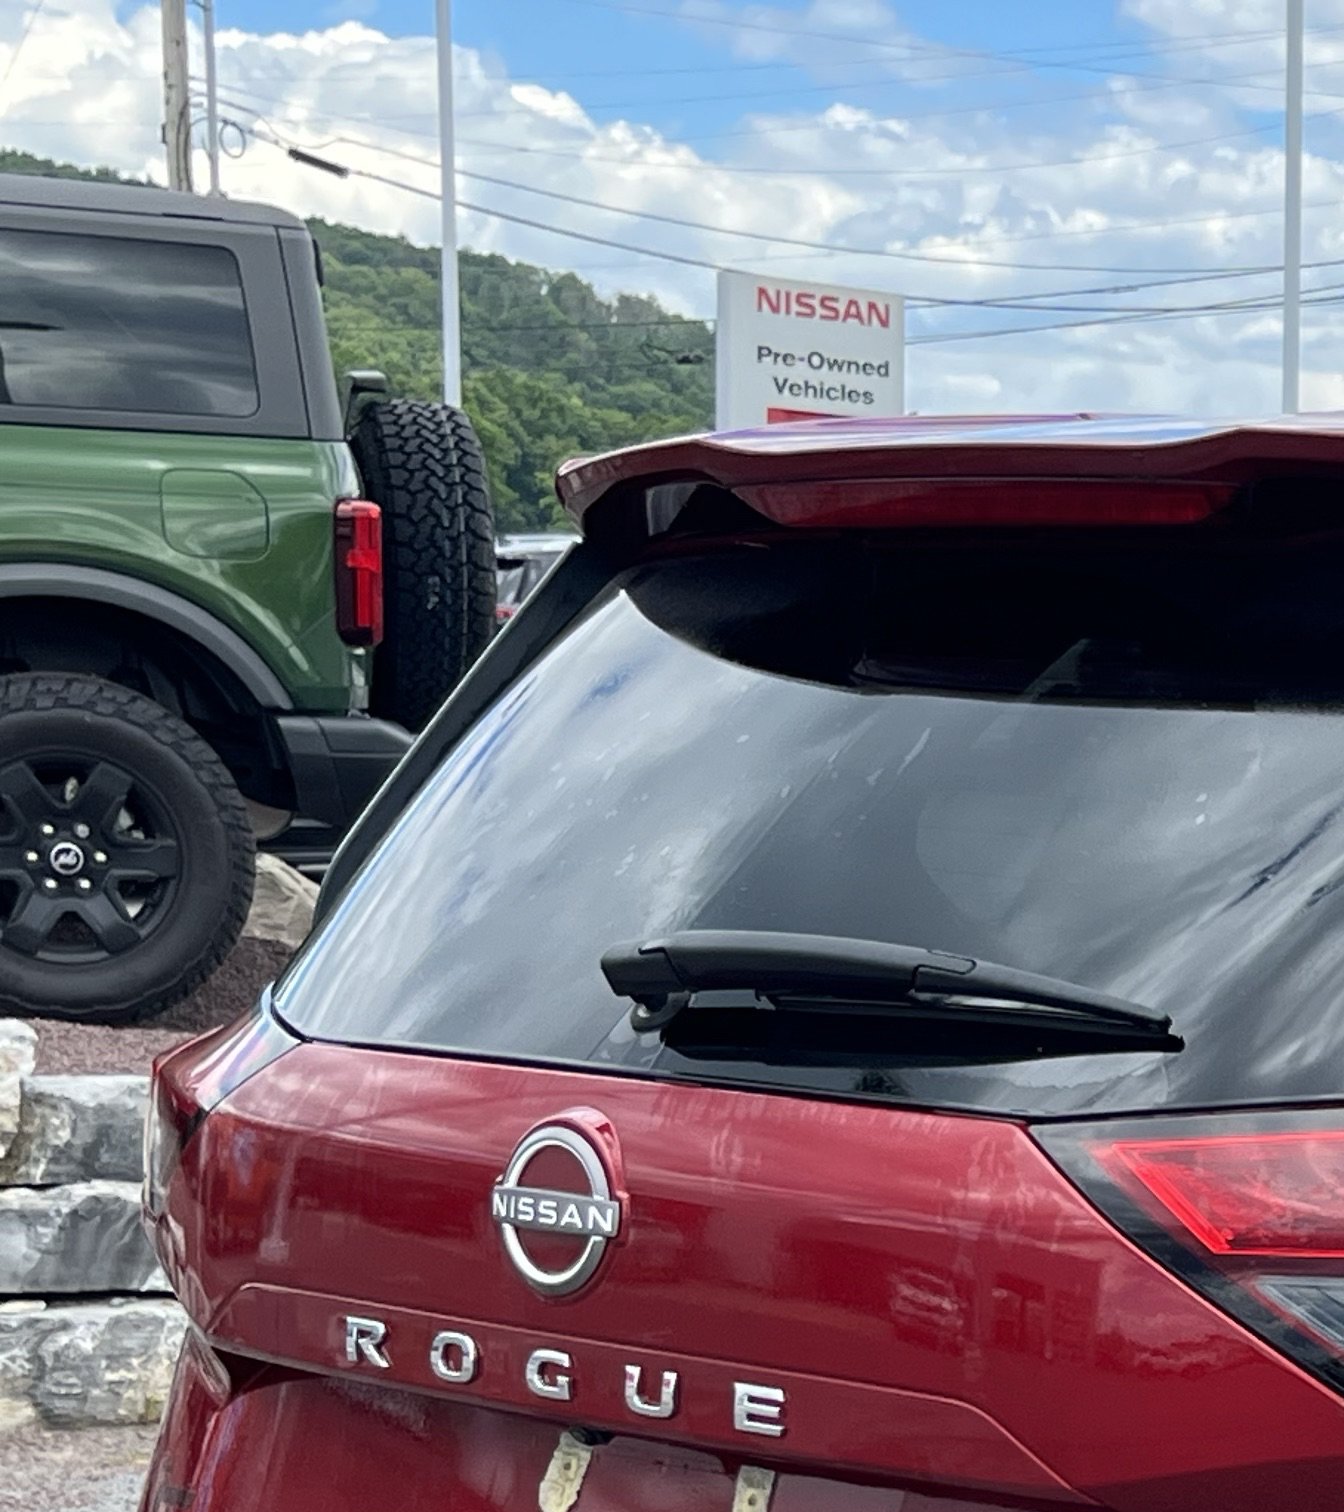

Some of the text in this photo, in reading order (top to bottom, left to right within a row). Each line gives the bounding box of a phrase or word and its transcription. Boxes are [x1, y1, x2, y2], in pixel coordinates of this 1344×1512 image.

[757, 286, 890, 328] NISSAN
[756, 345, 890, 377] Pre-Owned
[773, 376, 875, 405] Vehicles
[492, 1191, 615, 1234] NISSAN
[345, 1314, 786, 1437] ROGUE
